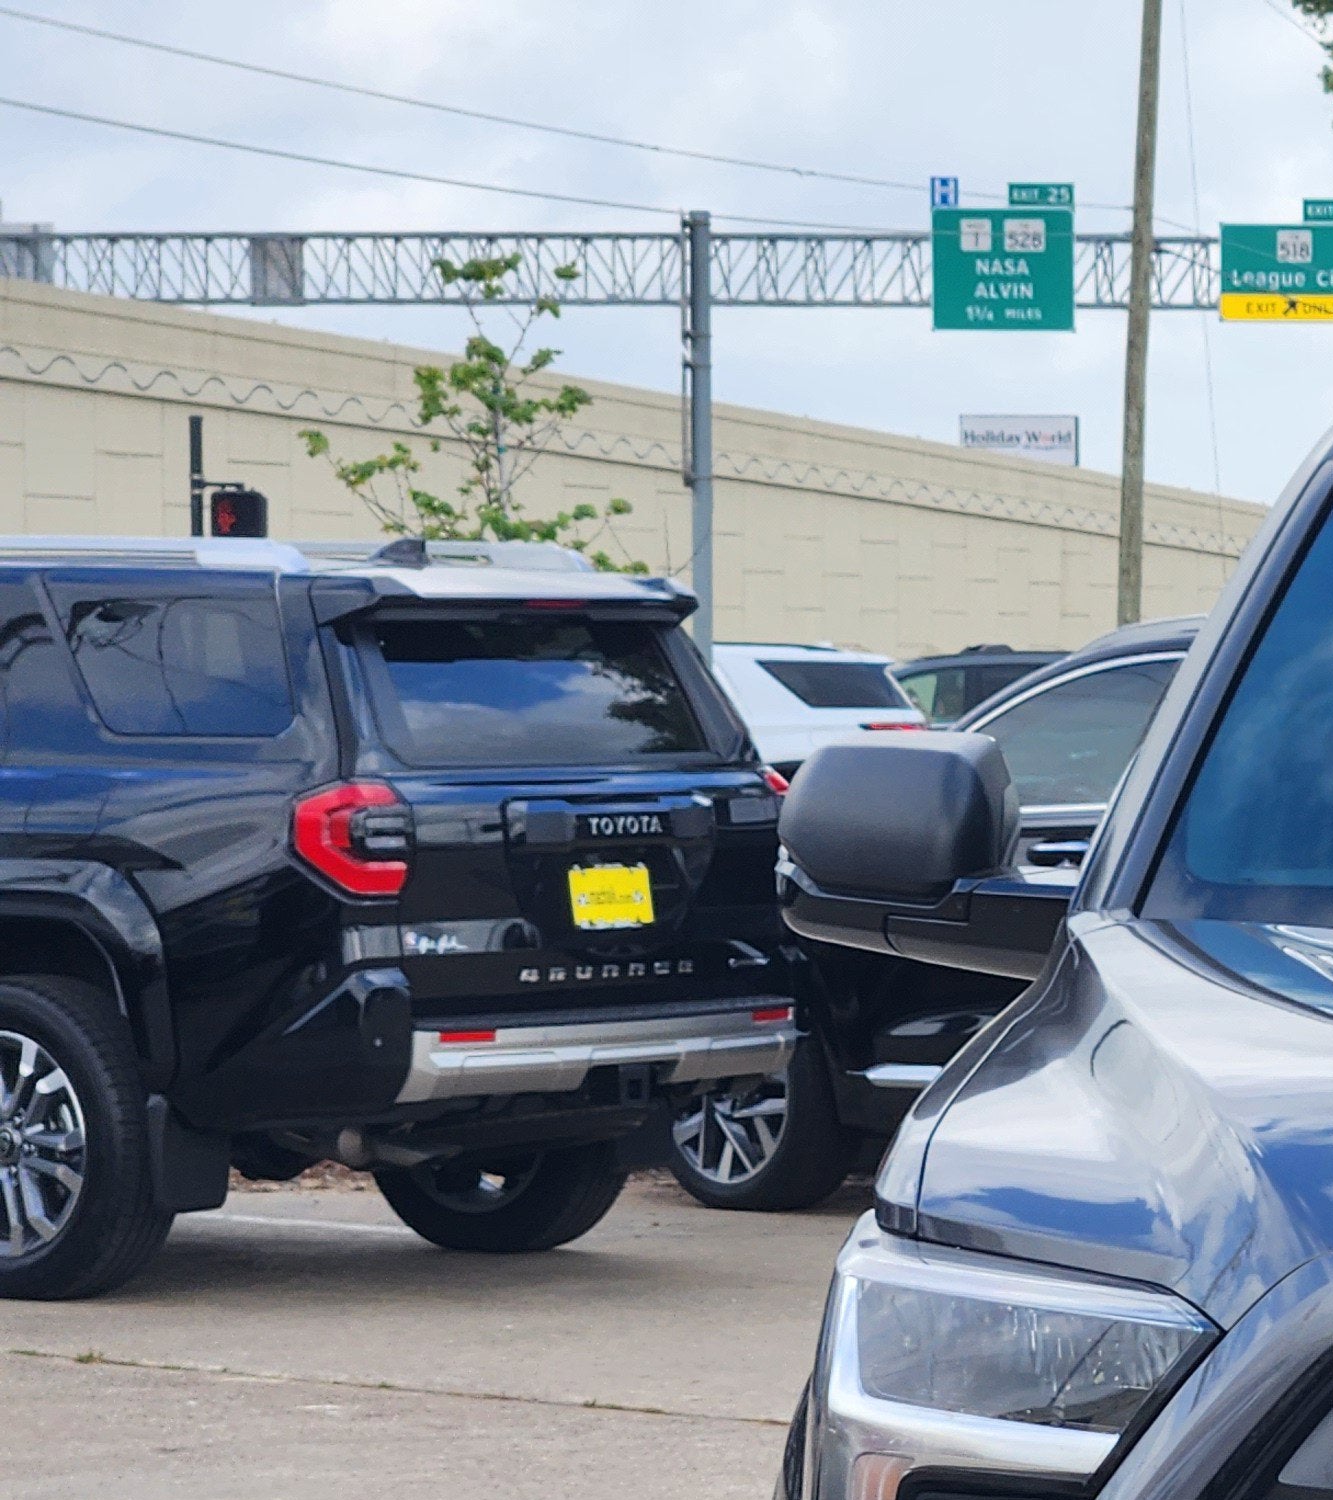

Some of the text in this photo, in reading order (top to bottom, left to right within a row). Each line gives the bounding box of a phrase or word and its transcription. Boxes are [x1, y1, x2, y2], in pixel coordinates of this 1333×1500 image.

[1307, 204, 1333, 217] EXIT
[1279, 241, 1309, 258] 518
[975, 259, 1029, 275] NASA
[1231, 269, 1306, 290] League
[973, 282, 1034, 299] ALVIN
[1246, 302, 1277, 314] EXIT
[963, 429, 1072, 445] Holiday World
[587, 815, 662, 835] TOYOTA
